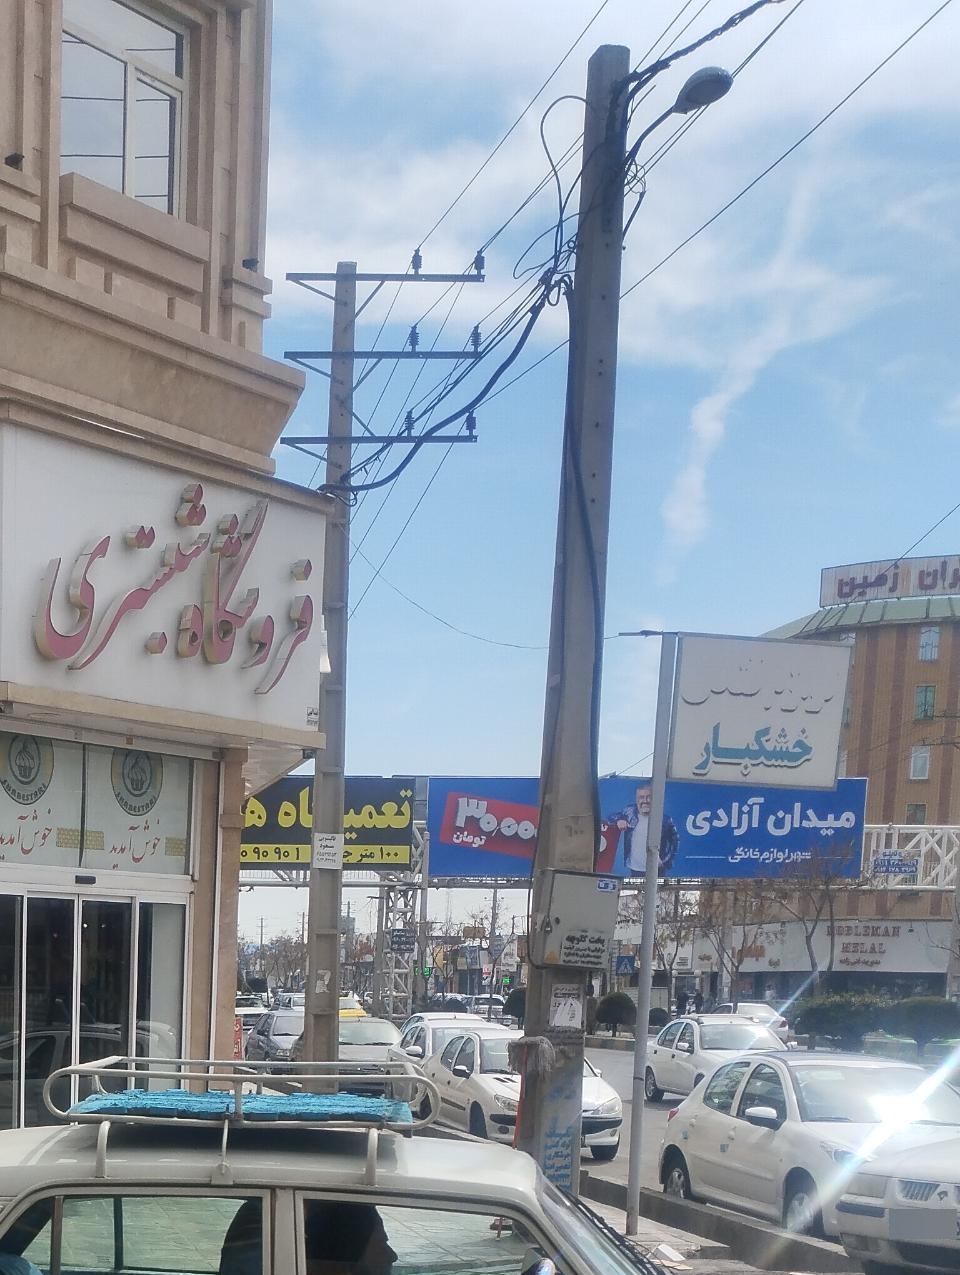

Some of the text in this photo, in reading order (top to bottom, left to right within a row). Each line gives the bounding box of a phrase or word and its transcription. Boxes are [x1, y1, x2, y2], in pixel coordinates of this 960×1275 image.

[32, 483, 313, 695] فروشگاه شبستری
[837, 563, 900, 599] زمین
[692, 721, 815, 777] خشکبار
[685, 797, 856, 836] میدان آزادی
[452, 831, 487, 848] تومان
[356, 849, 376, 863] متر
[380, 846, 399, 860] ۱۰۰
[728, 847, 760, 863] خانگی
[760, 848, 789, 863] لوازم
[841, 942, 886, 954] MELAL
